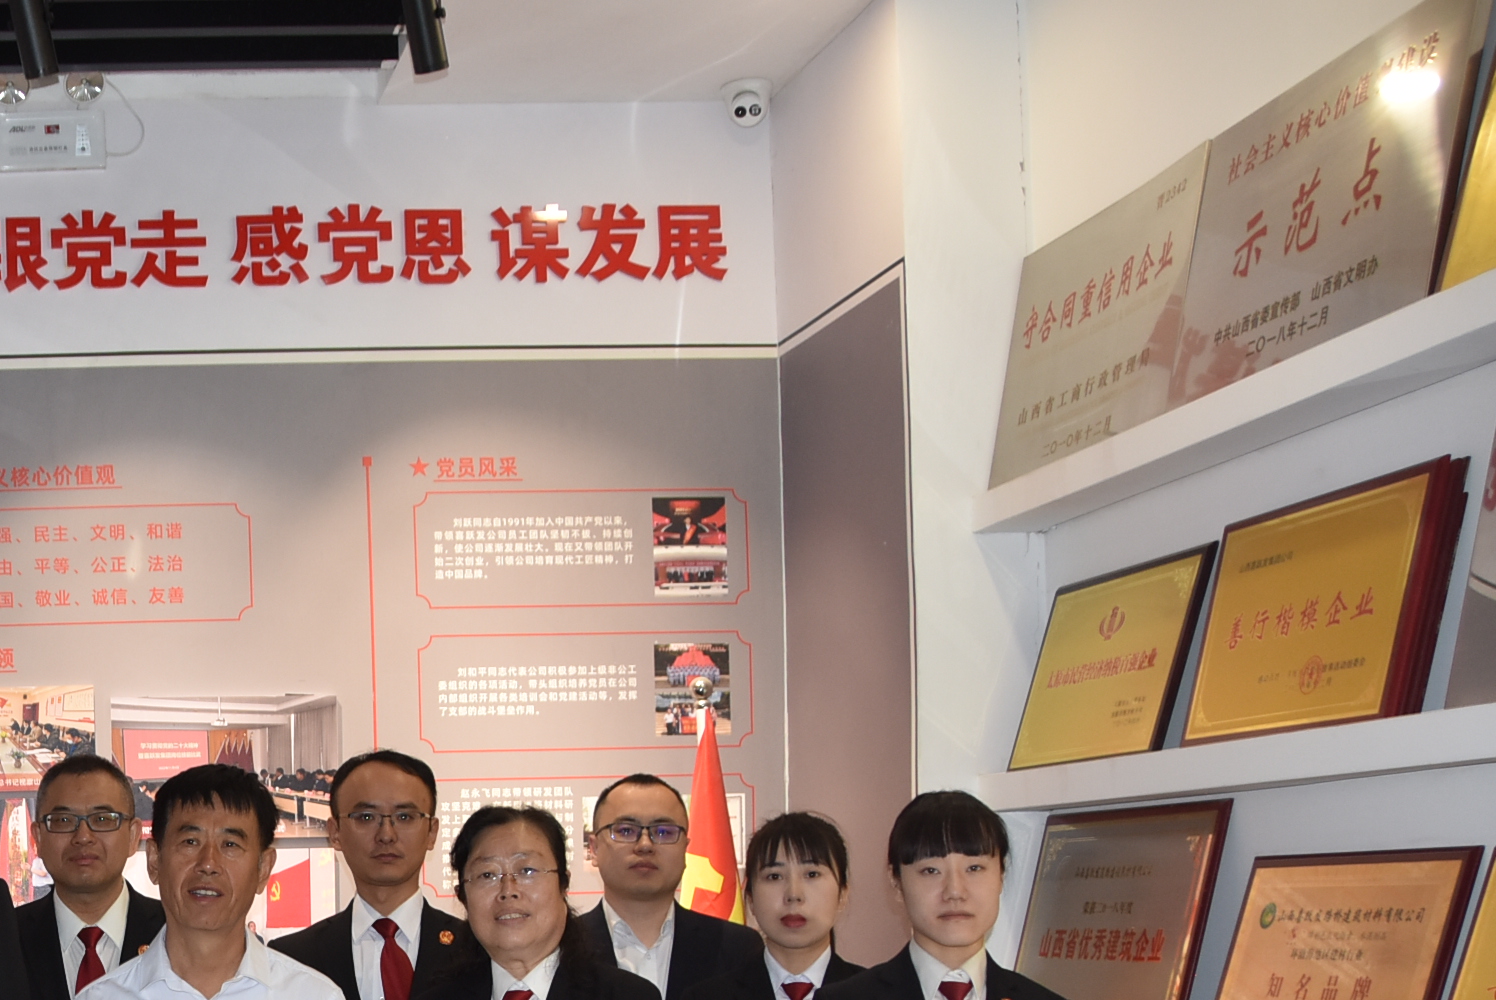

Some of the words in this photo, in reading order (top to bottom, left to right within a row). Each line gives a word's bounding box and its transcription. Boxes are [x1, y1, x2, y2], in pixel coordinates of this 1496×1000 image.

[1228, 30, 1441, 186] 社会主义核心价值建设
[230, 204, 470, 286] 感党恩
[491, 202, 730, 284] 谋发展
[1232, 137, 1383, 278] 示范点
[1023, 230, 1174, 350] 守合同重信用企业
[1213, 290, 1301, 347] 中共山西省委宣传部
[1311, 254, 1379, 302] 山西省文明办
[1017, 347, 1151, 427] 山西省工商行政管理局
[436, 456, 518, 478] 党员风采
[1228, 586, 1374, 651] 善行楷模企业
[460, 786, 574, 798] 赵永飞同志带领研发团队
[1039, 927, 1166, 963] 山西省优秀建筑企业
